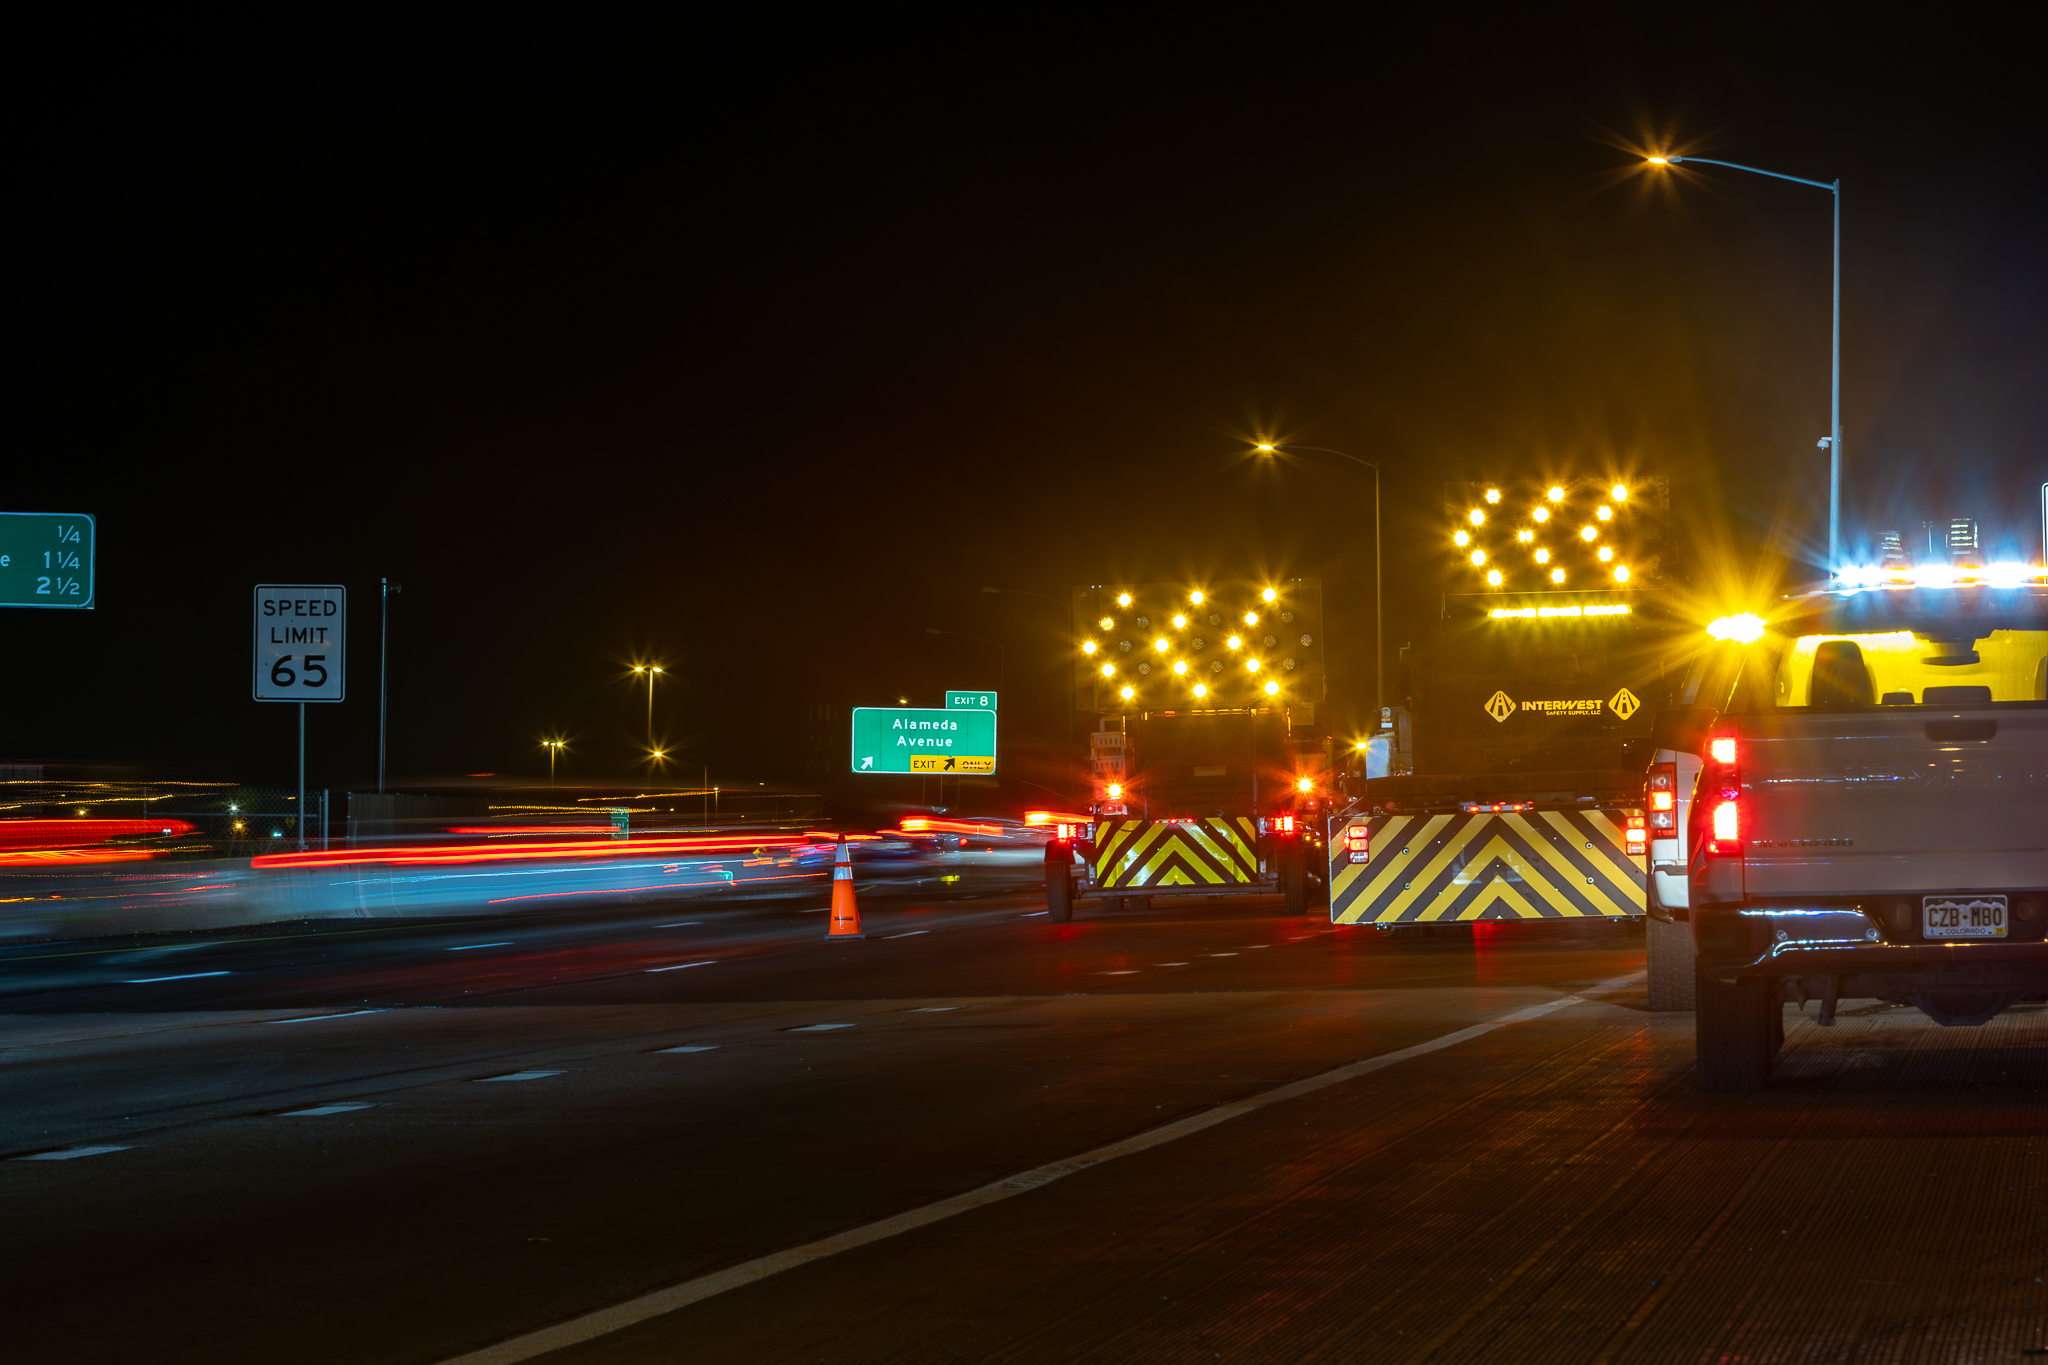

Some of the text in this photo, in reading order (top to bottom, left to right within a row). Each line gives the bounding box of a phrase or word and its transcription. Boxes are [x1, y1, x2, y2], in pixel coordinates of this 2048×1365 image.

[263, 599, 337, 616] SPEED
[271, 627, 328, 644] LIMIT
[271, 654, 328, 688] 65
[954, 696, 989, 707] EXIT 8
[1521, 699, 1603, 711] INTERWEST
[892, 718, 958, 731] Alameda
[896, 735, 953, 747] Avenue
[913, 760, 992, 770] EXIT ONLY
[1751, 838, 1853, 848] SILVERADO
